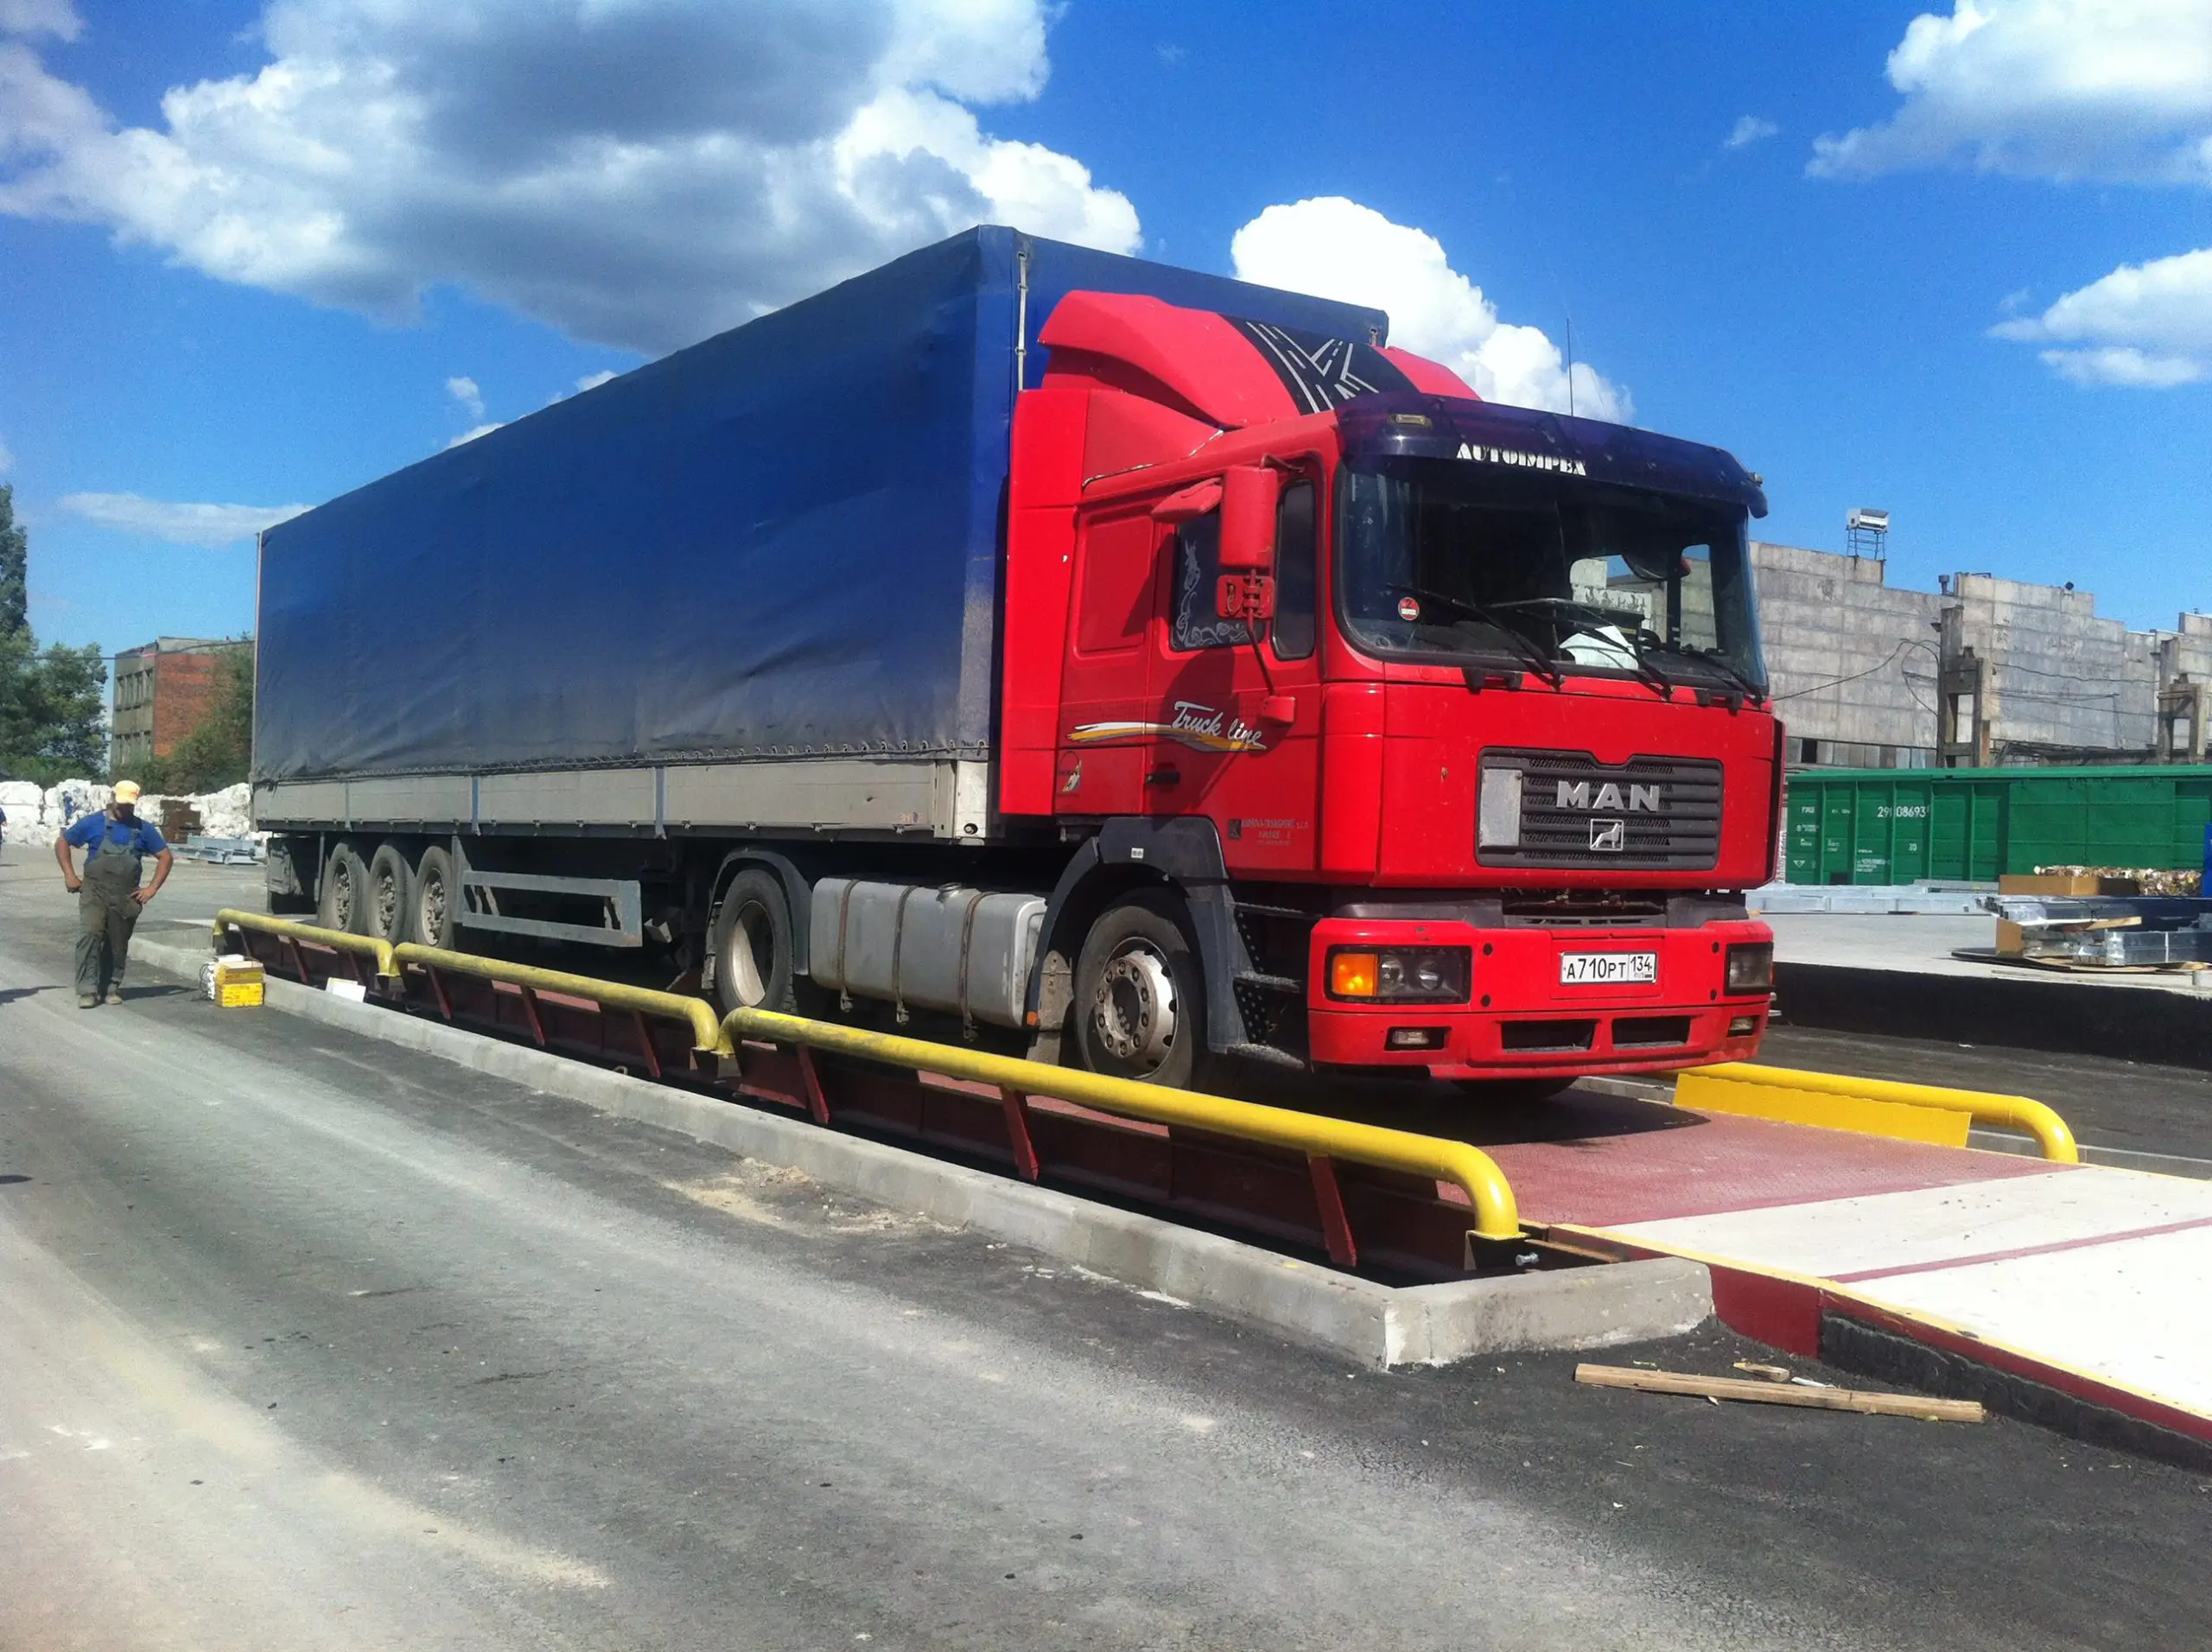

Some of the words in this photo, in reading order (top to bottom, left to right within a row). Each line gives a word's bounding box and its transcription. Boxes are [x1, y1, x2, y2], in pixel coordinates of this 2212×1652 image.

[1456, 442, 1587, 476] AUTOIMPEX
[1171, 701, 1224, 736] Truck
[1227, 718, 1268, 750] line
[1555, 780, 1661, 812] MAN
[1630, 956, 1651, 972] 134
